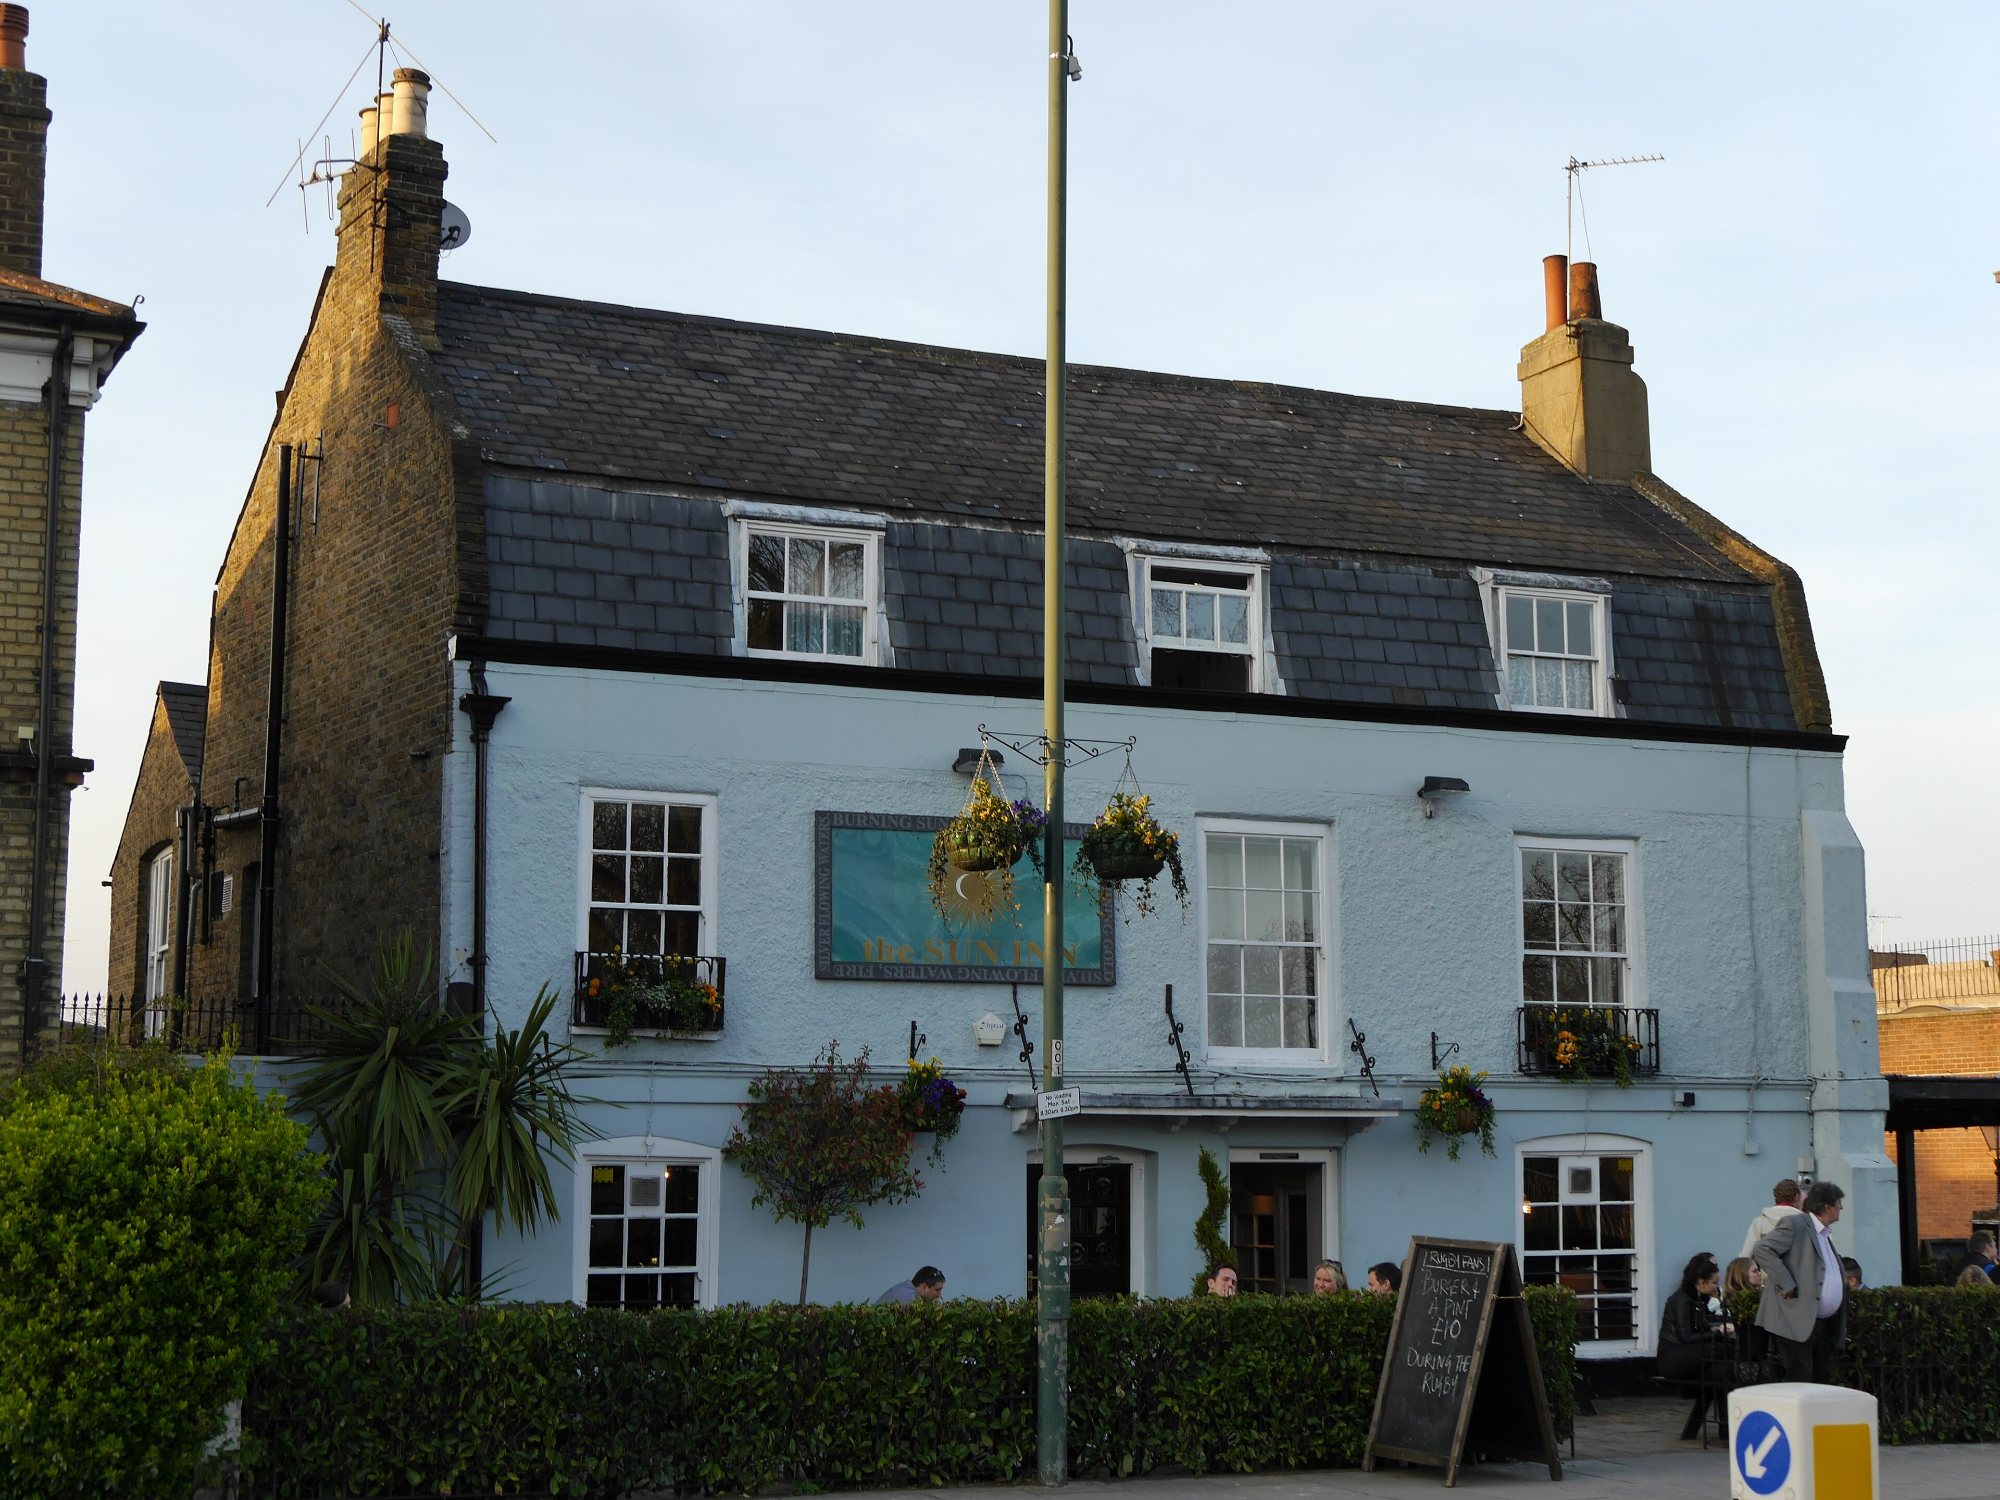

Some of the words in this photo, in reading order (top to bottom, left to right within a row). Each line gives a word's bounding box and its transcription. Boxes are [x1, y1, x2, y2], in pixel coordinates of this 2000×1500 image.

[833, 812, 911, 829] BURNING
[864, 936, 913, 963] the
[924, 938, 999, 965] SUN
[834, 964, 873, 978] FIRE
[957, 967, 1039, 982] FLOWING
[1444, 1298, 1473, 1320] PINT
[1431, 1317, 1461, 1345] £10
[1407, 1346, 1451, 1374] DURING
[1455, 1354, 1472, 1373] THE
[1422, 1371, 1459, 1398] RUGBY
